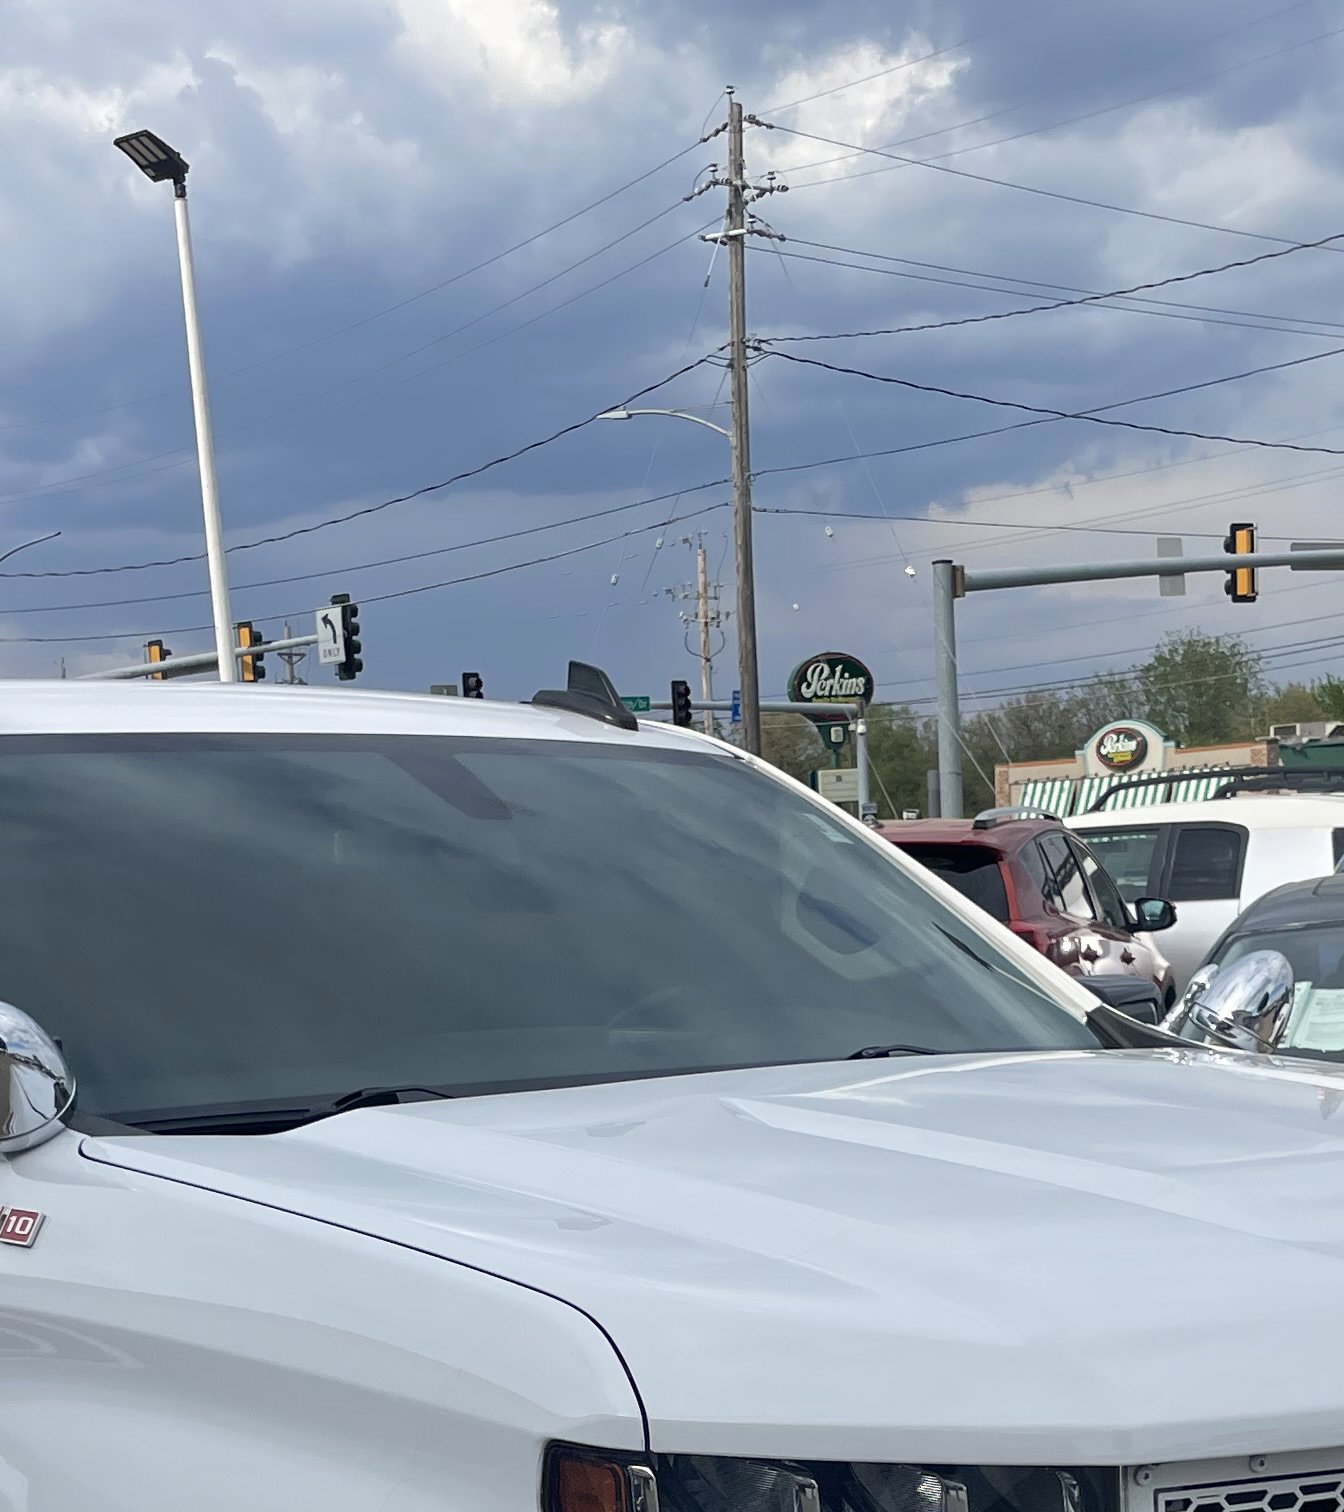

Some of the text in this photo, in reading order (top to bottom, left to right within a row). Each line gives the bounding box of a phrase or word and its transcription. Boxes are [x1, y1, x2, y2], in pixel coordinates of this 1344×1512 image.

[322, 647, 341, 659] ONLY
[800, 662, 865, 699] Perkins
[6, 1215, 34, 1235] 10
